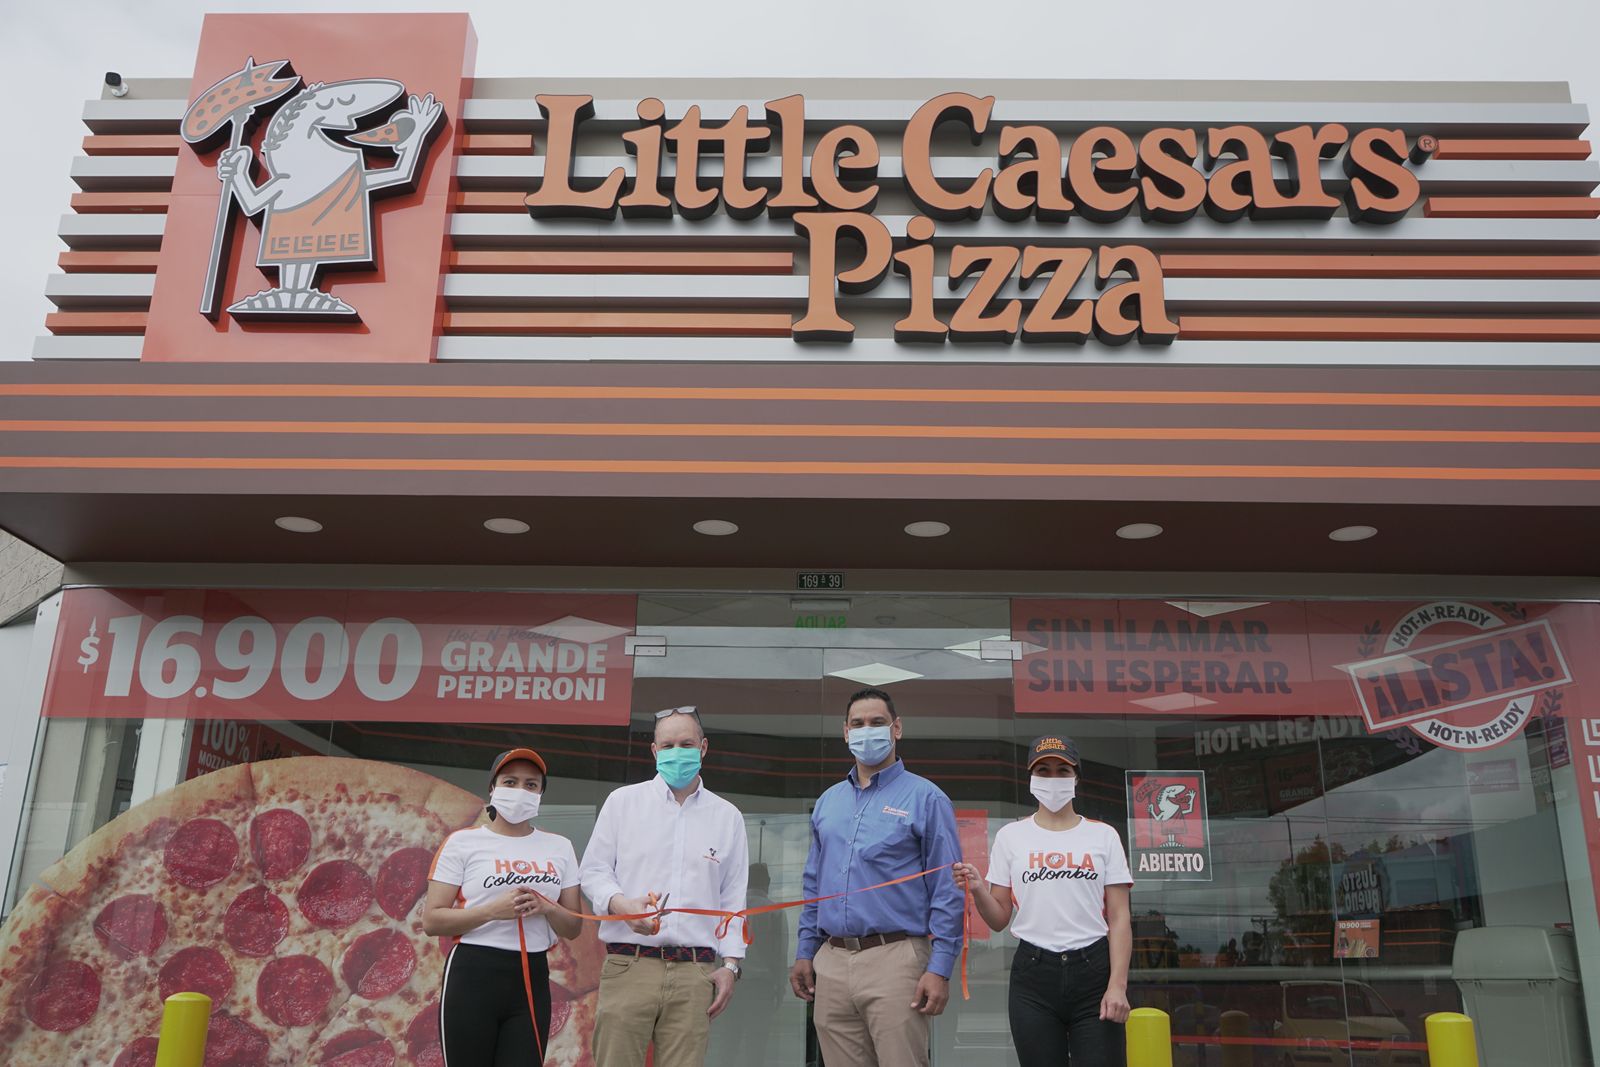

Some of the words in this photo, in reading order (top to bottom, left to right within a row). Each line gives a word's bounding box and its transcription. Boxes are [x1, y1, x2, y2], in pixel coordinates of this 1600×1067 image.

[523, 93, 881, 214] Little
[902, 92, 1421, 214] Caesars
[791, 211, 1180, 337] Pizza
[801, 574, 819, 588] 169
[828, 574, 841, 588] 39
[1026, 618, 1092, 651] SIN
[1103, 618, 1272, 653] LLAMAR
[1392, 604, 1492, 648] HOT-N-READY
[440, 641, 608, 674] GRANDE
[436, 675, 606, 702] PEPPERONI
[1027, 659, 1095, 693] SIN
[1106, 660, 1293, 695] ESPERAR
[1194, 716, 1362, 757] HOT-N-READY
[1427, 701, 1526, 745] HOT-N-READY
[200, 719, 250, 763] 100%
[495, 859, 558, 877] HOLA
[1022, 866, 1099, 884] Colombia
[1029, 852, 1095, 871] HOLA
[1138, 852, 1204, 873] ABIERTO
